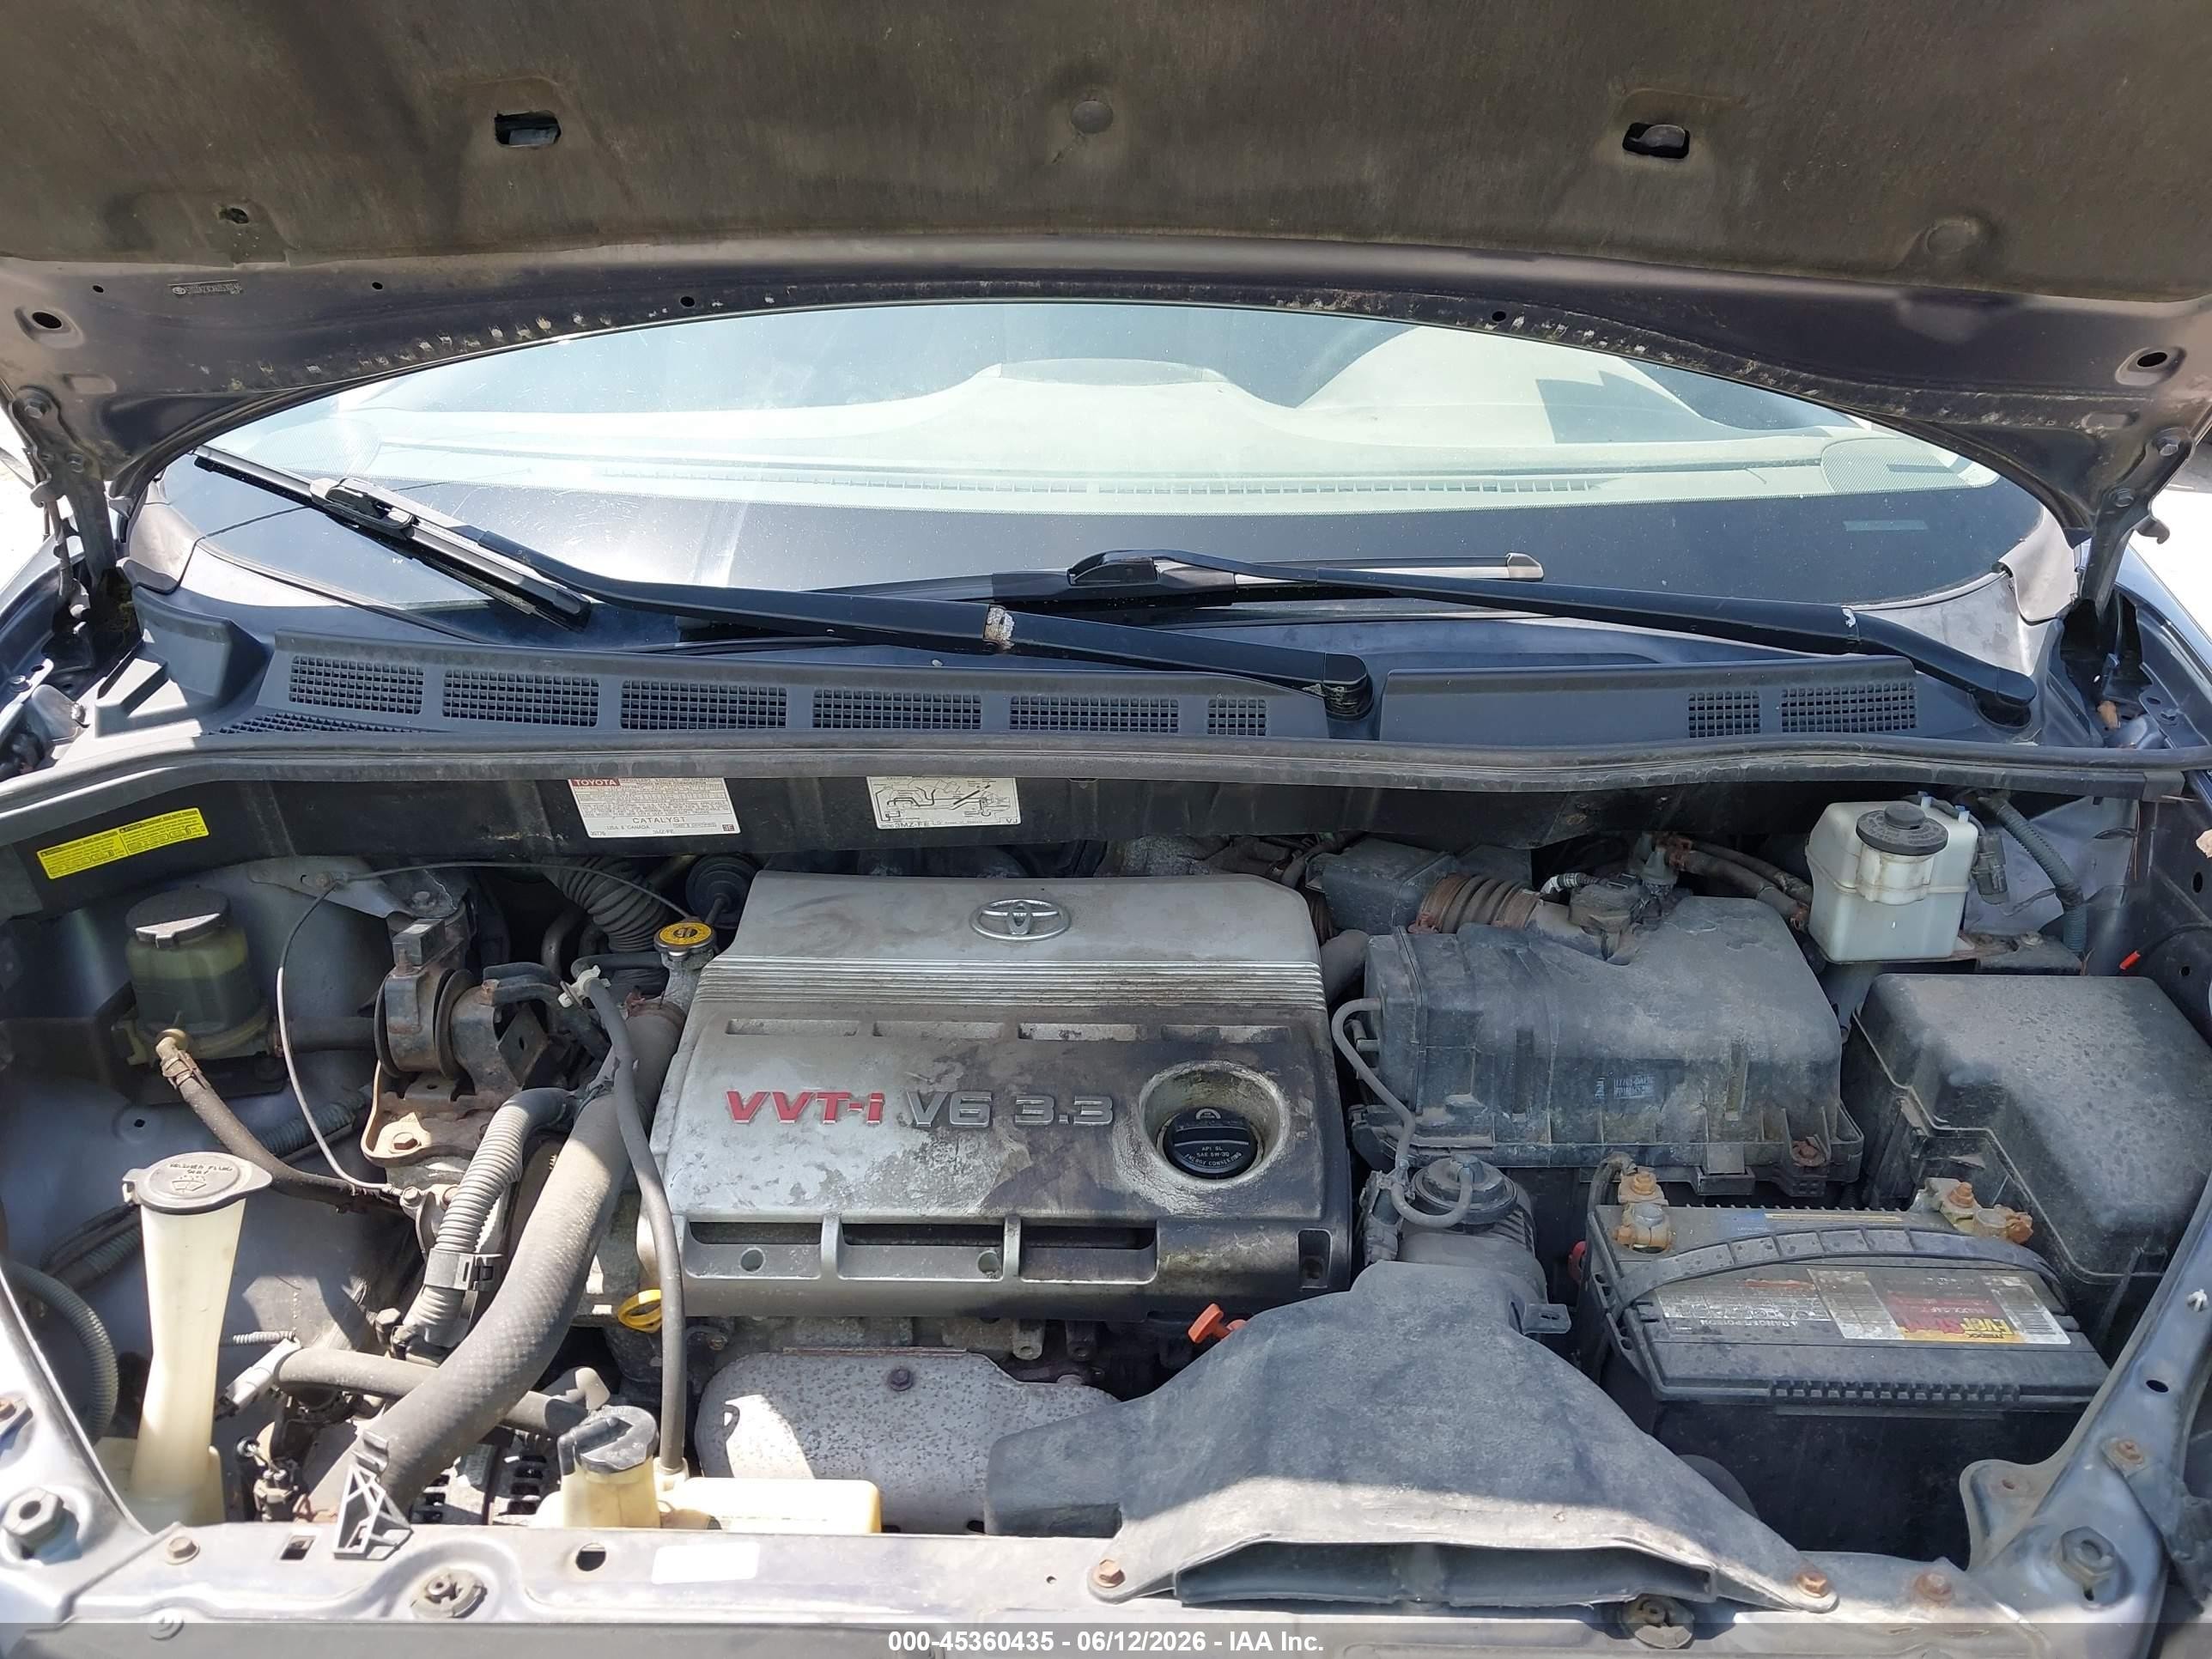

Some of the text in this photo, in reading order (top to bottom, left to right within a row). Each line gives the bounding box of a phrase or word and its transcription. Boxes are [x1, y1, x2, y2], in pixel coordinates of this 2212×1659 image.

[574, 778, 616, 787] TOYOTA
[726, 1090, 1115, 1127] VVT-i V6 3.3
[1184, 1153, 1206, 1165] ENERGY
